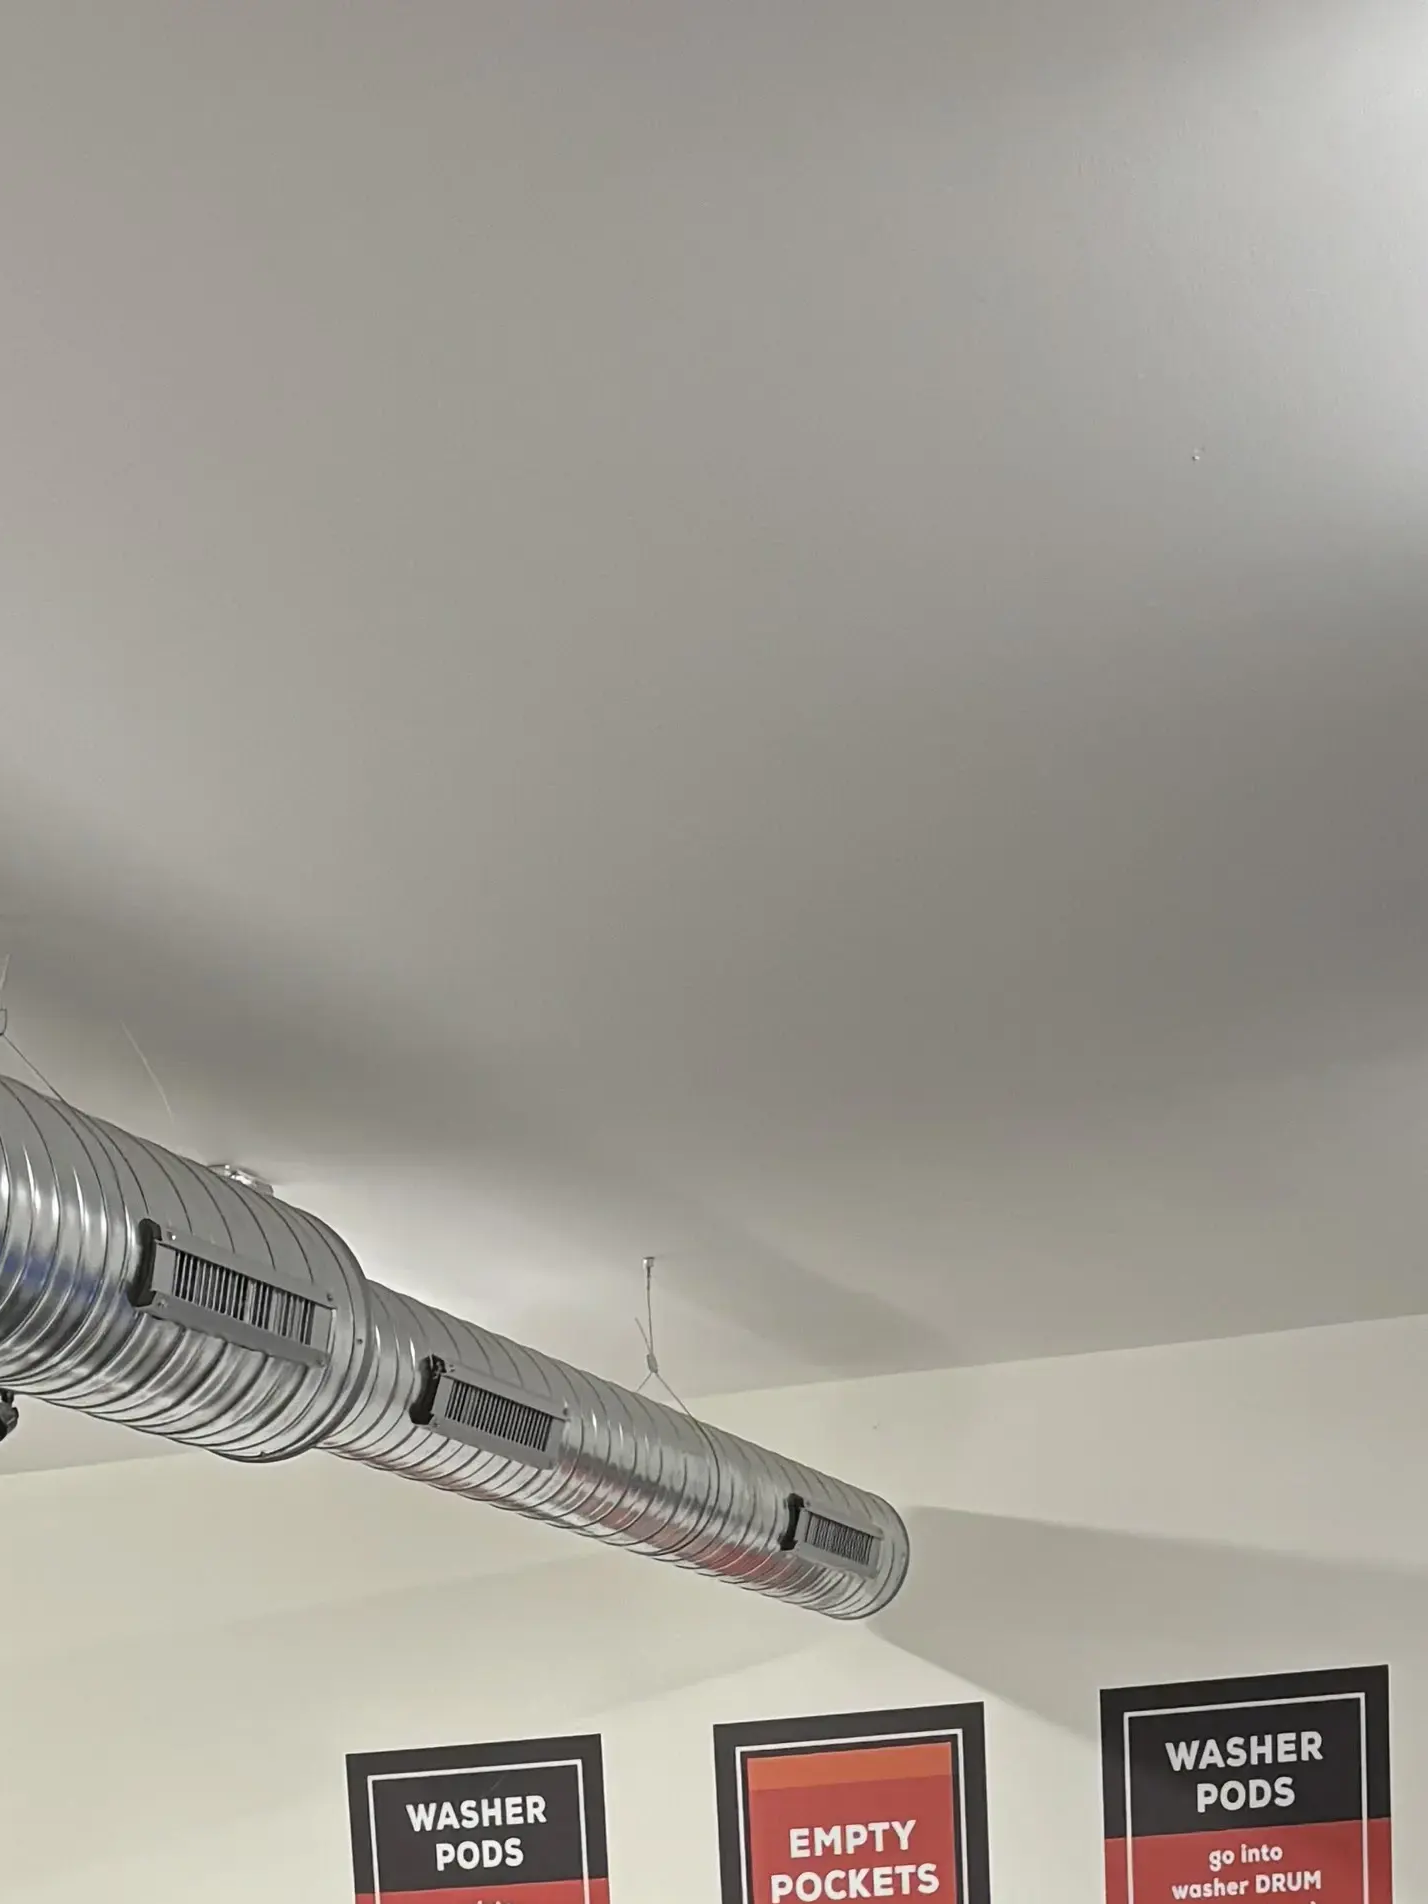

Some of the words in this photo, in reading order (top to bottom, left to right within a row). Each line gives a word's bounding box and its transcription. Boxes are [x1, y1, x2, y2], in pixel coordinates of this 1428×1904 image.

[1164, 1730, 1324, 1772] WASHER
[405, 1794, 548, 1832] WASHER
[1196, 1776, 1296, 1814] PODS
[435, 1837, 525, 1872] PODS
[789, 1819, 917, 1859] EMPTY
[1208, 1849, 1236, 1873] go
[1240, 1843, 1284, 1864] into
[770, 1862, 941, 1904] POCKETS
[1171, 1877, 1250, 1900] washer
[1255, 1869, 1323, 1894] DRUM
